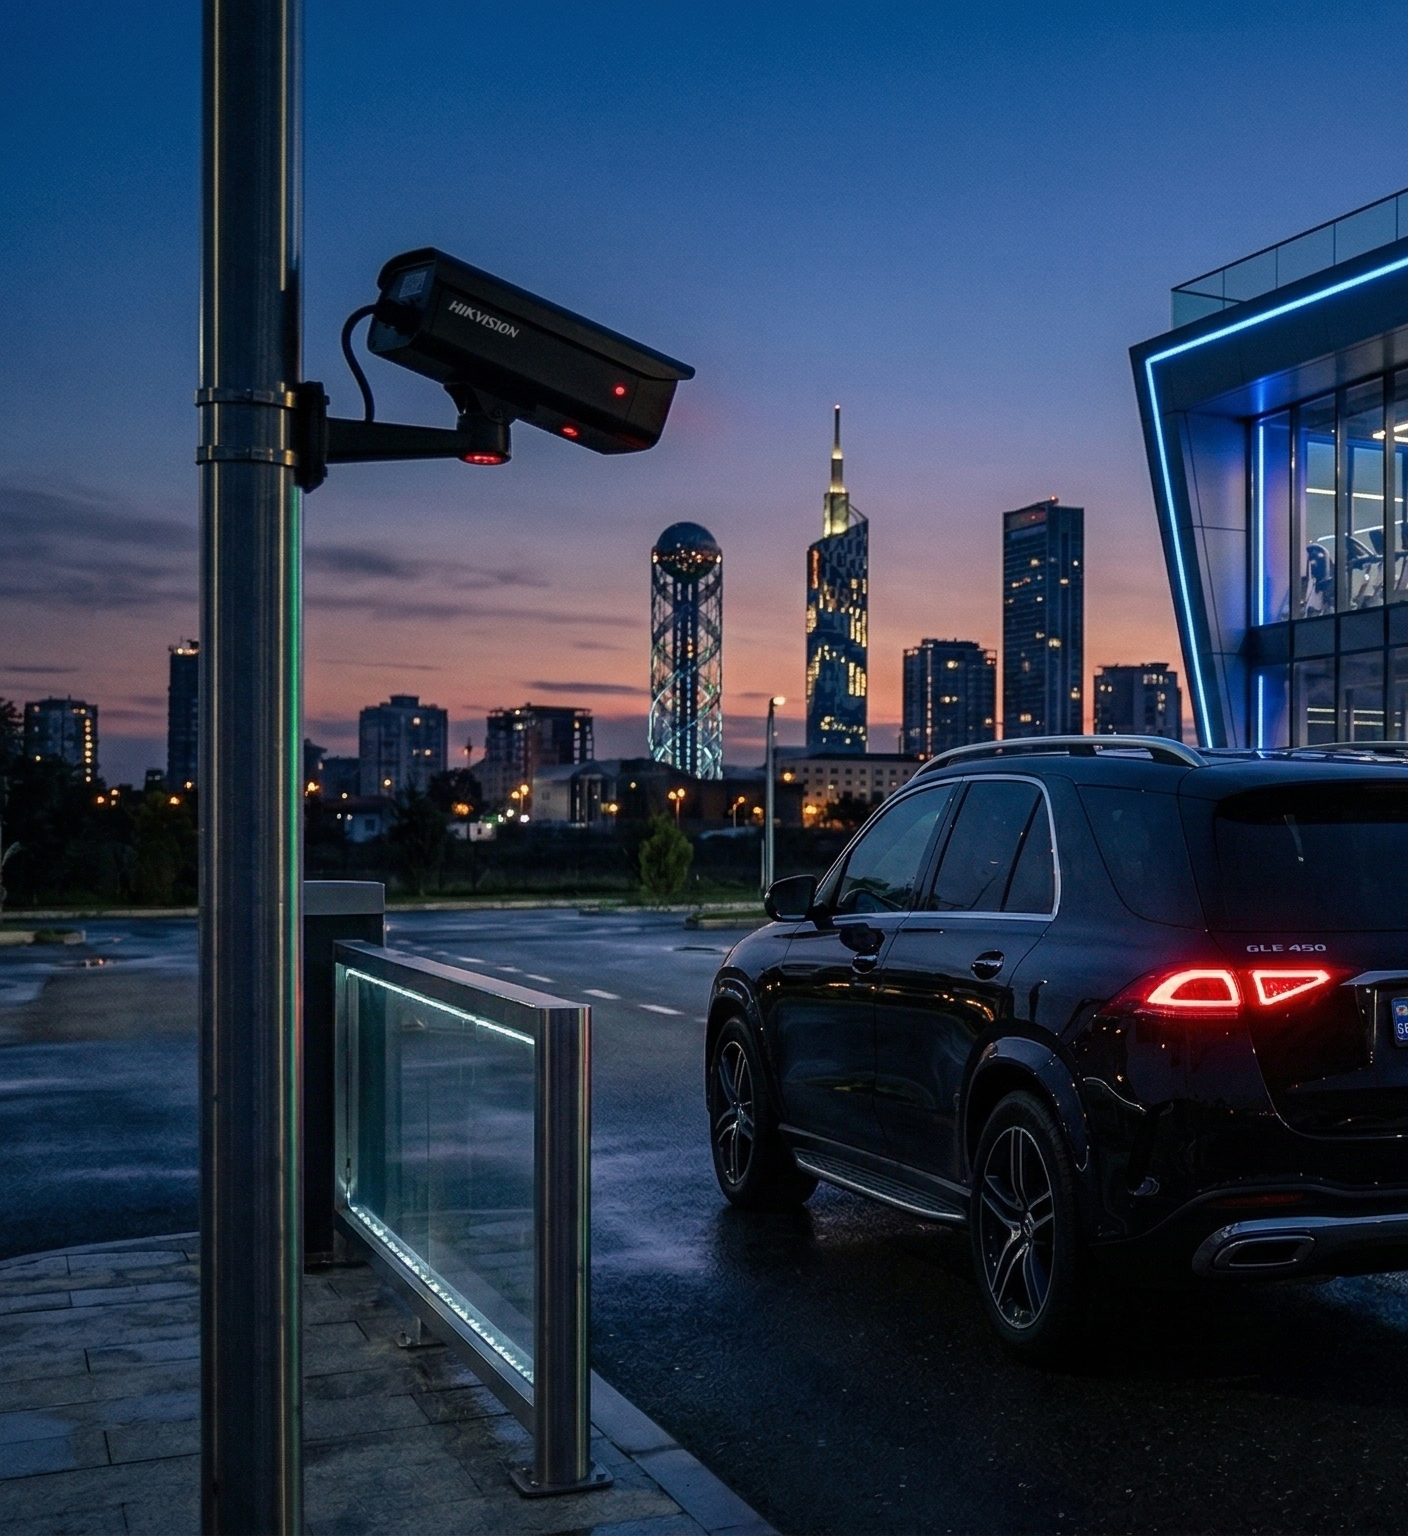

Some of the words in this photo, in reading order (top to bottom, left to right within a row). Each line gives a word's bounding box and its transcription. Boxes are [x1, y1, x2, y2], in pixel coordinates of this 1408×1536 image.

[448, 301, 520, 338] HIKVISION
[1246, 944, 1284, 953] GLE
[1288, 943, 1327, 952] 450
